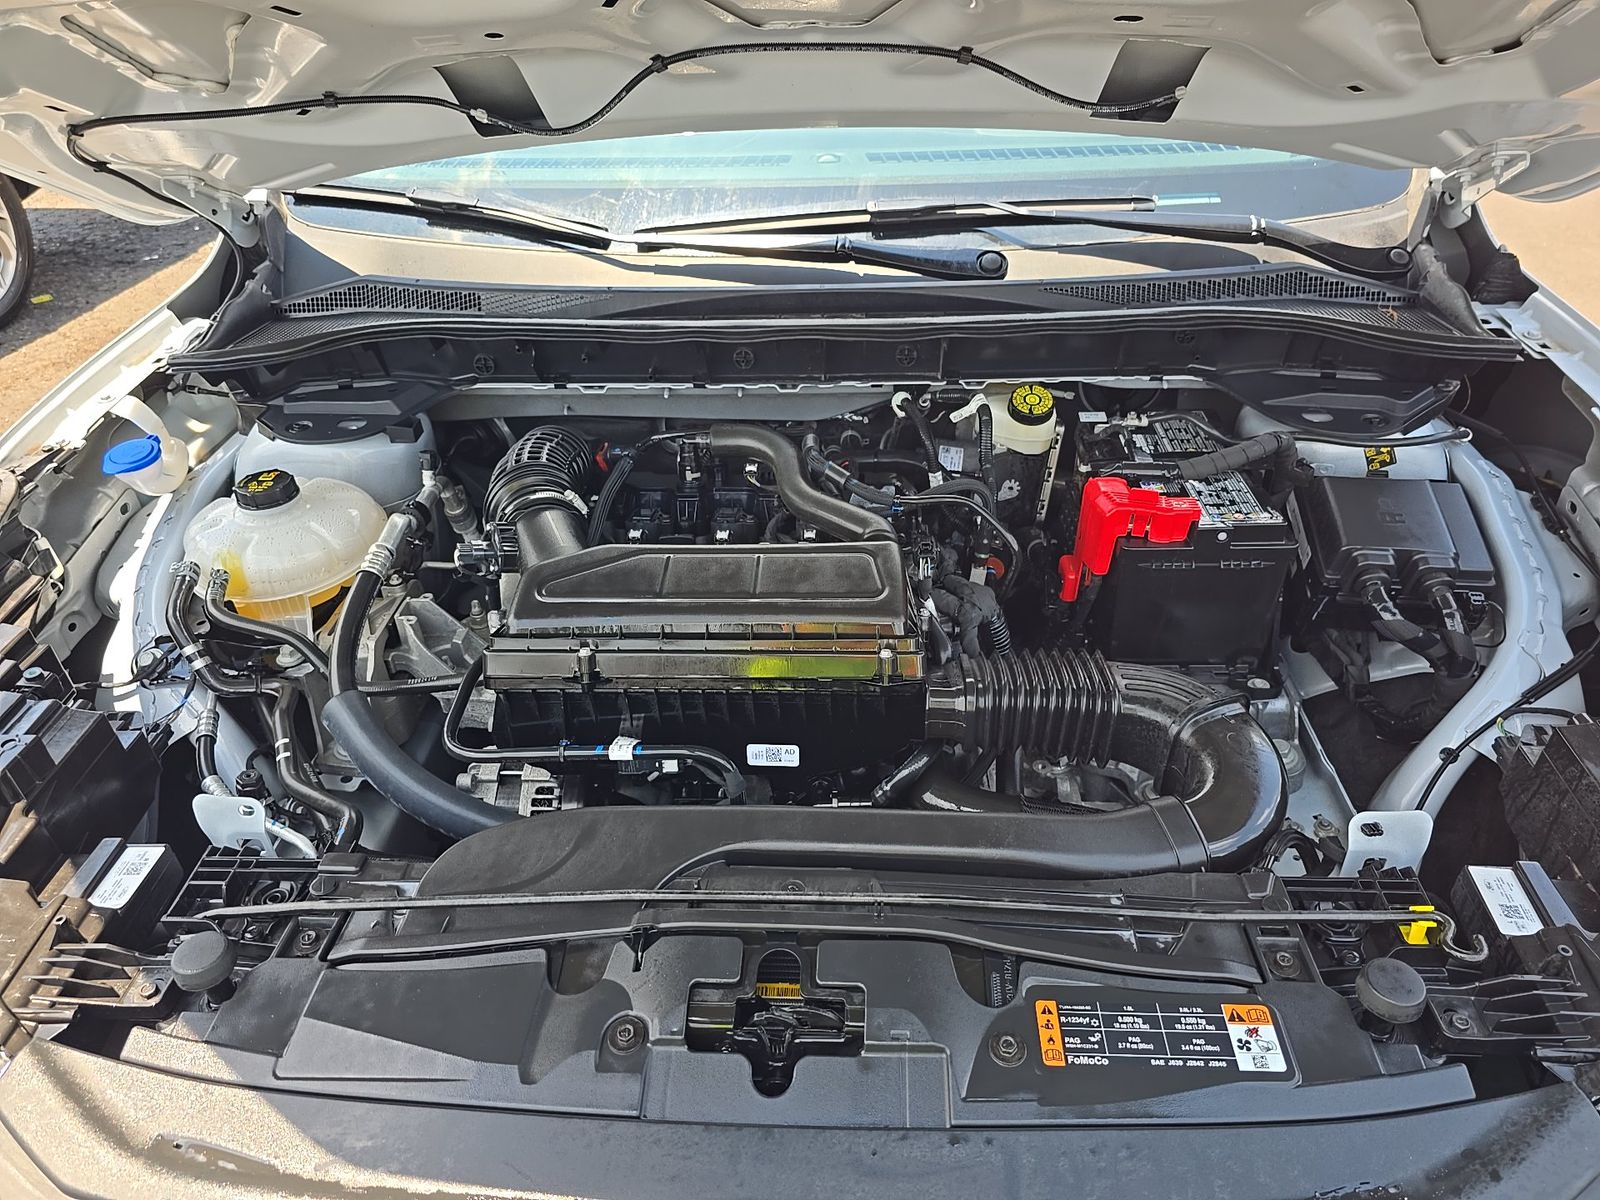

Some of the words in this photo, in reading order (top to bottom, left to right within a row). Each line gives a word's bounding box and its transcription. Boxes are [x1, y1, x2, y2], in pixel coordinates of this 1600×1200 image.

[784, 748, 796, 756] AD
[1060, 1016, 1090, 1025] R-1234yf
[1134, 1016, 1143, 1025] kg
[1197, 1017, 1207, 1025] kg
[1064, 1036, 1081, 1044] PAG
[1067, 1055, 1109, 1066] FoMoCo
